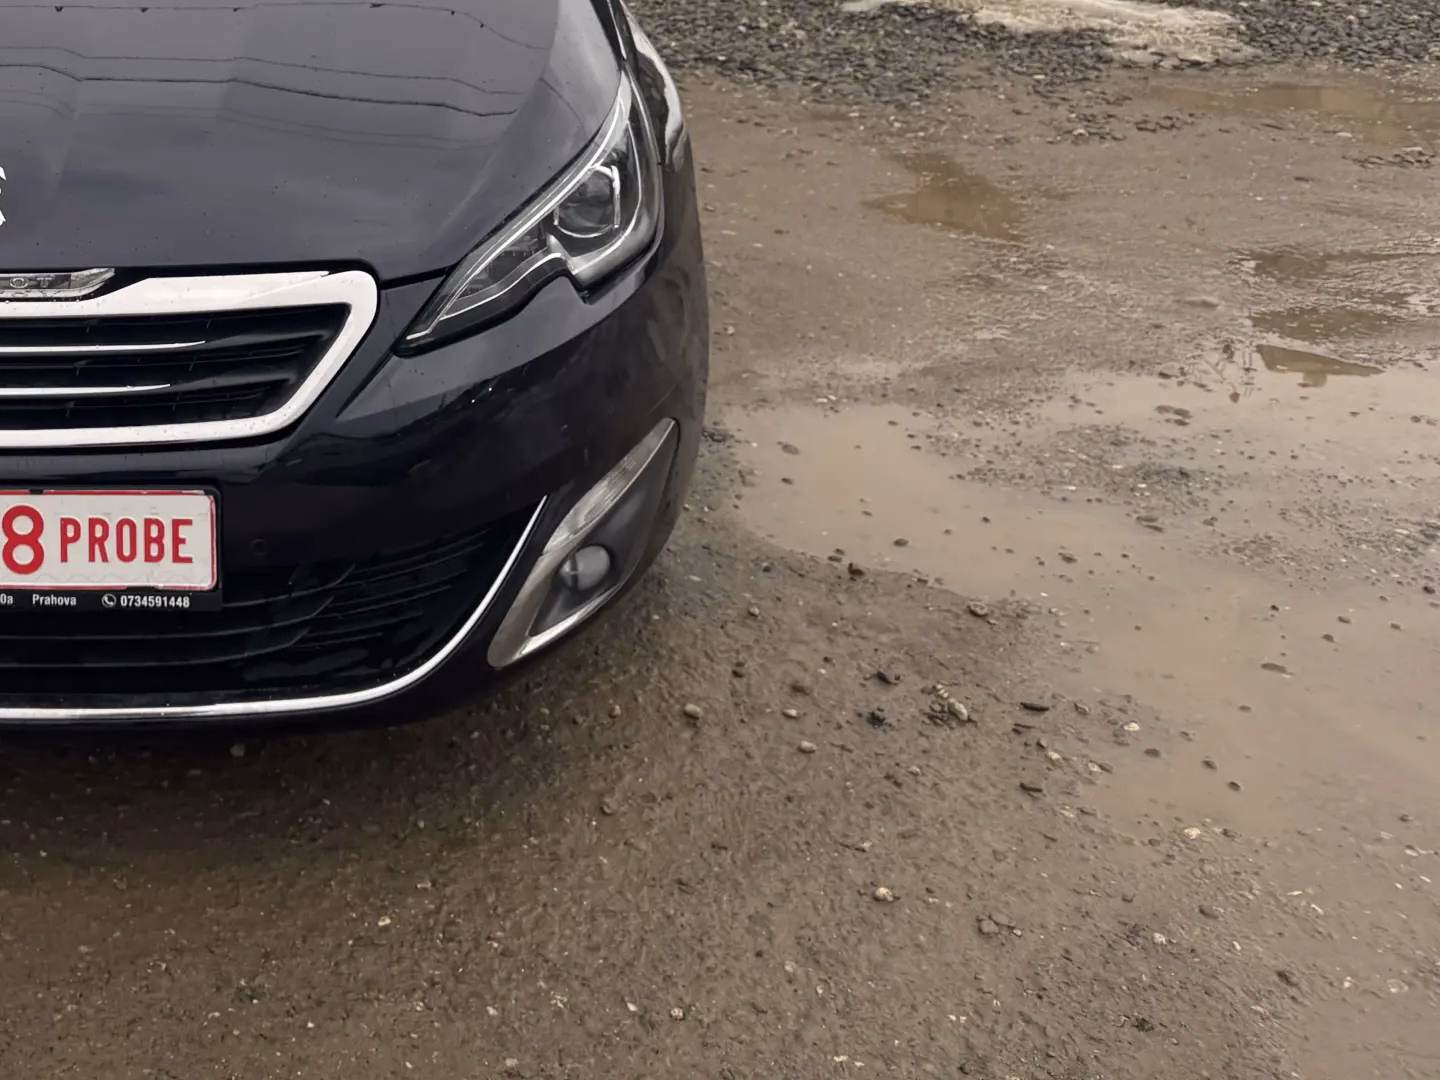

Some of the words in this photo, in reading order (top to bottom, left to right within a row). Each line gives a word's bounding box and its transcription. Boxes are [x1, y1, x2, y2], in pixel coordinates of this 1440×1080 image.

[60, 516, 194, 564] PROBE
[32, 593, 77, 606] Prahova
[120, 595, 190, 608] 0734591448
